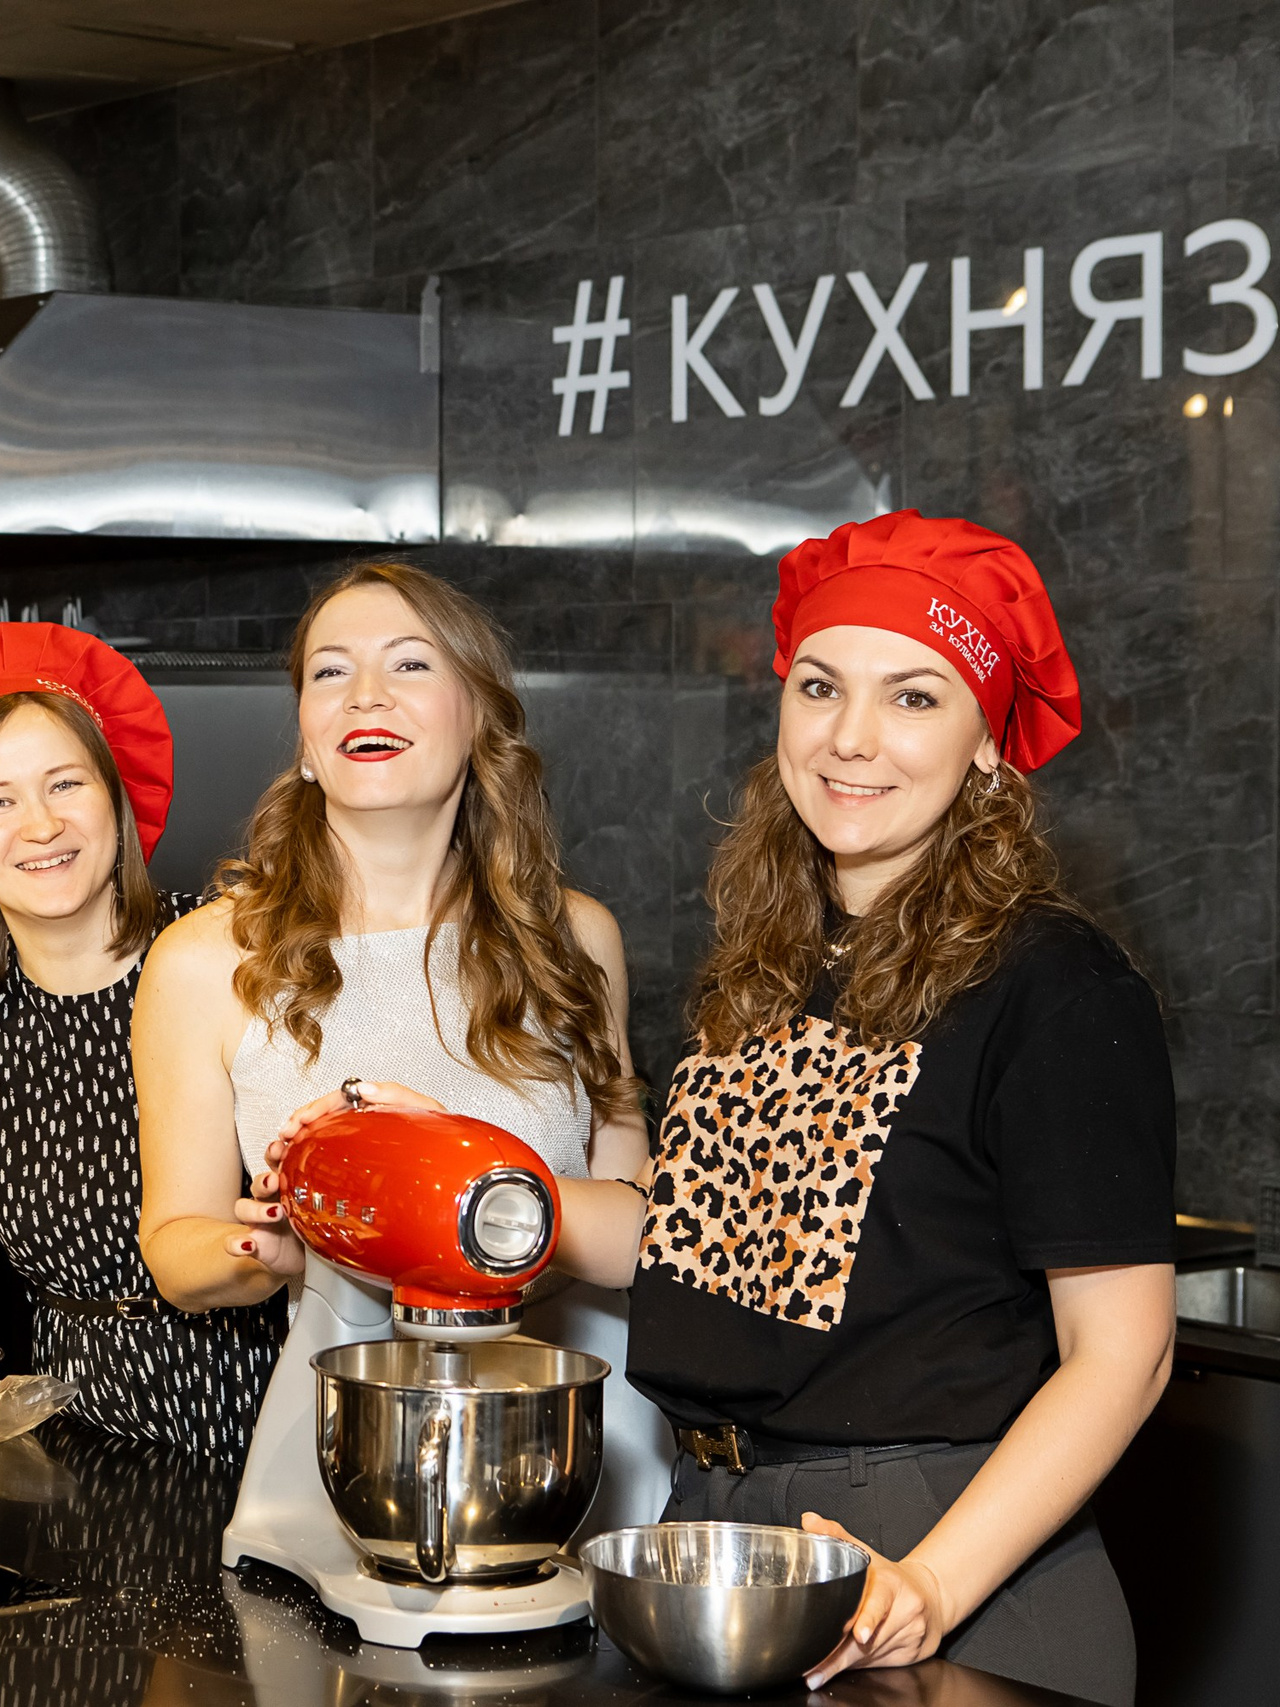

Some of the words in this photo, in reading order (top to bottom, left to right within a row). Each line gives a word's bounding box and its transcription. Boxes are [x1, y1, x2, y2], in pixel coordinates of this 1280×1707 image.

[926, 597, 1001, 678] КУХНЯ
[929, 621, 944, 637] ЗА
[948, 633, 987, 684] КУЛИСАМИ
